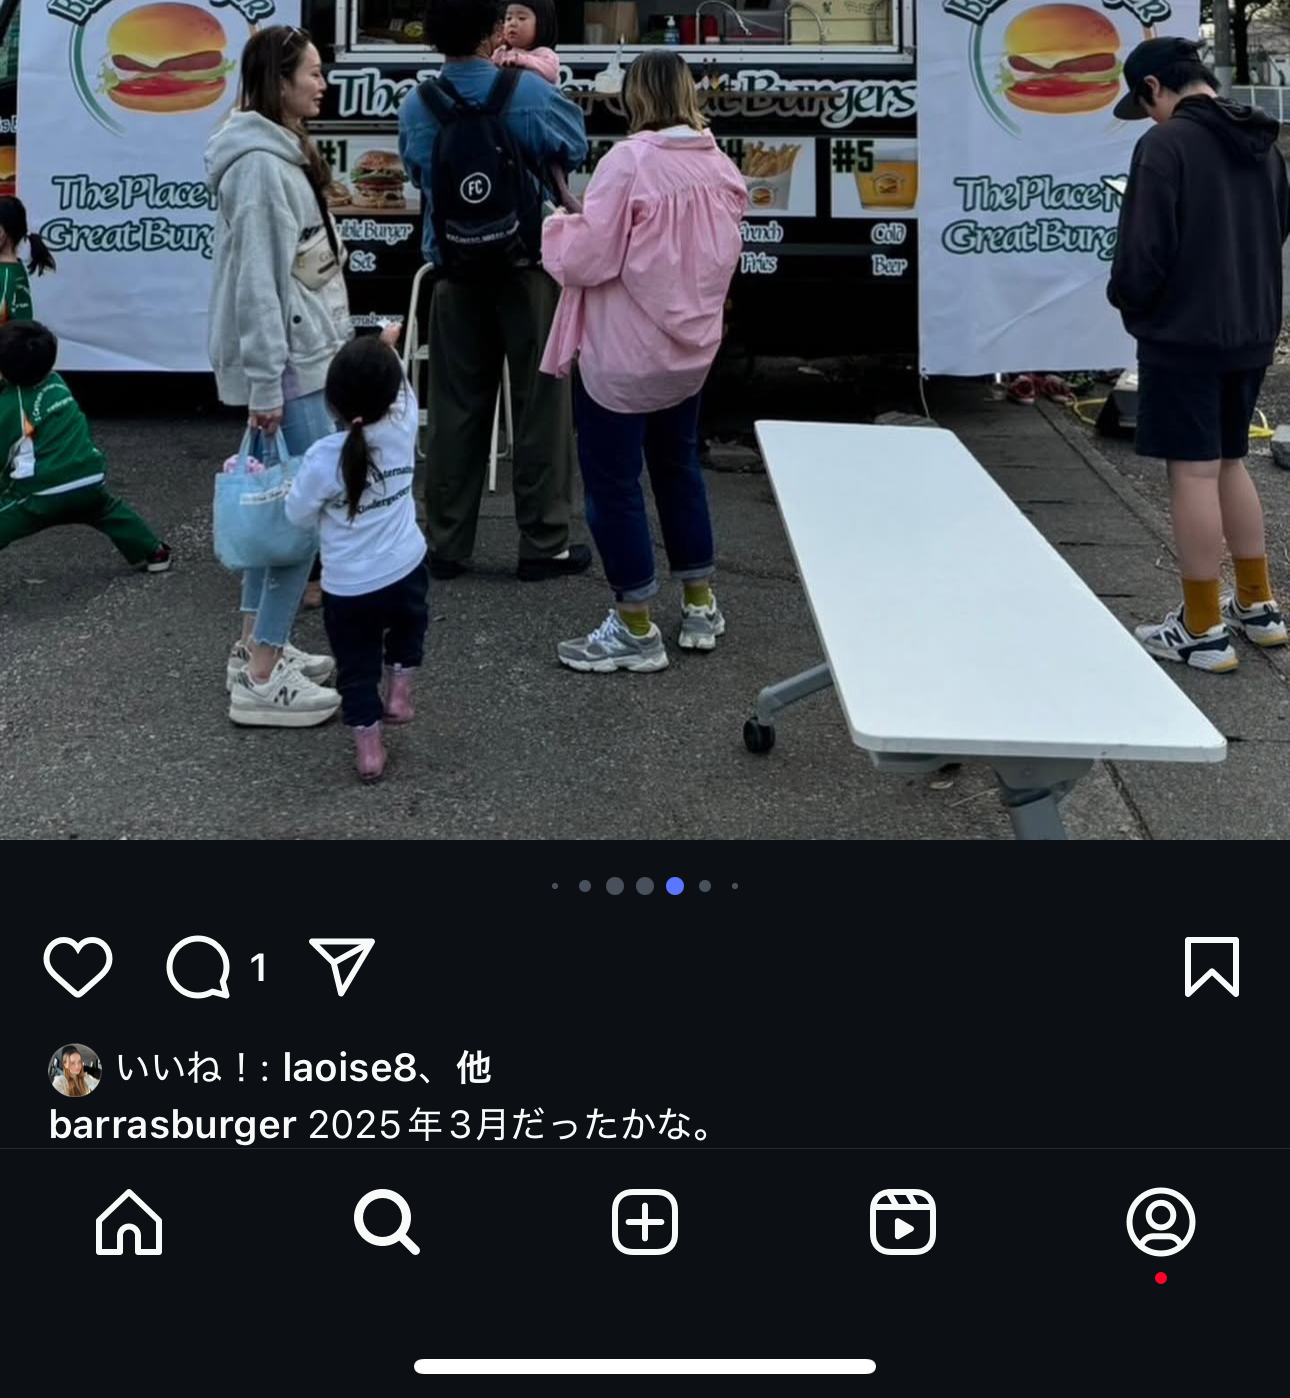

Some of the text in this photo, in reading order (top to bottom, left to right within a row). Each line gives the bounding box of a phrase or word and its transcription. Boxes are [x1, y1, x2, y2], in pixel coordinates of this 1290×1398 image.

[832, 140, 874, 173] #5
[52, 175, 120, 210] The
[119, 175, 208, 210] Place
[468, 179, 483, 196] FC
[954, 175, 1019, 211] The
[1017, 175, 1103, 211] Place
[41, 218, 143, 253] Great
[942, 219, 1038, 253] Great
[872, 254, 908, 276] Beer
[1162, 627, 1184, 647] N
[250, 953, 265, 982] 1
[51, 1109, 296, 1145] barrasburger
